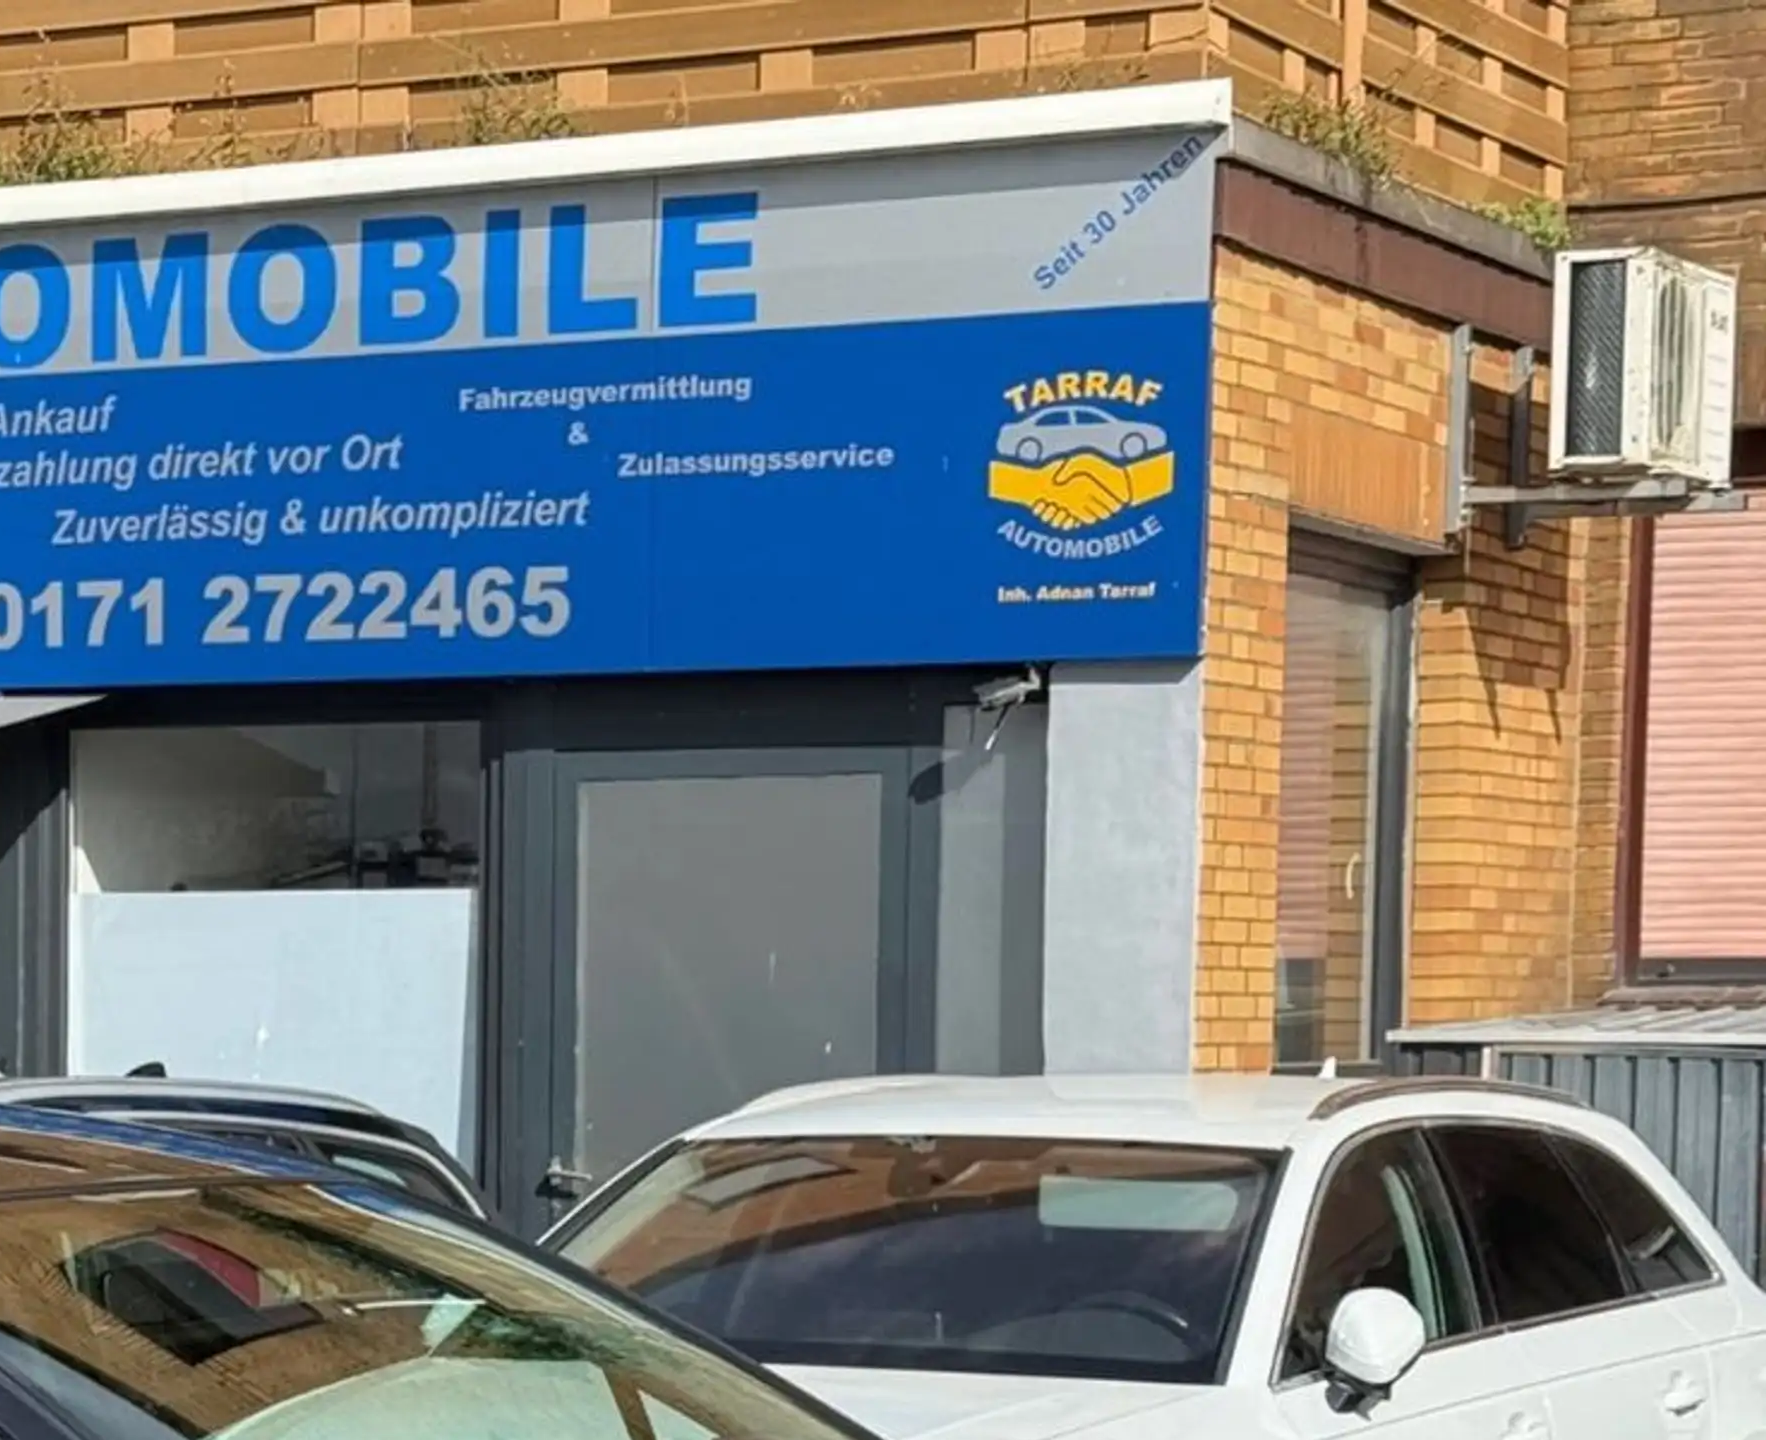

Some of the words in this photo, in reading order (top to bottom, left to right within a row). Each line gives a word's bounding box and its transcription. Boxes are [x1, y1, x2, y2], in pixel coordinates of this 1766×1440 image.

[1034, 240, 1085, 290] Seit
[1084, 211, 1116, 244] 30
[1121, 136, 1204, 215] Jahren
[459, 374, 752, 413] Fahrzeugvermittlung
[1003, 370, 1163, 413] TARRAF
[567, 421, 589, 444] &
[148, 440, 255, 480] direkt
[267, 442, 329, 474] vor
[342, 435, 402, 471] Ort
[617, 442, 894, 478] Zulassungsservice
[52, 502, 266, 545] Zuverlässig
[282, 499, 305, 533] &
[320, 489, 589, 538] unkompliziert
[997, 515, 1164, 559] AUTOMOBILE
[203, 566, 568, 645] 2722465
[998, 587, 1031, 602] Inh.
[1037, 586, 1093, 600] Adnan
[1099, 582, 1156, 599] Tarraf
